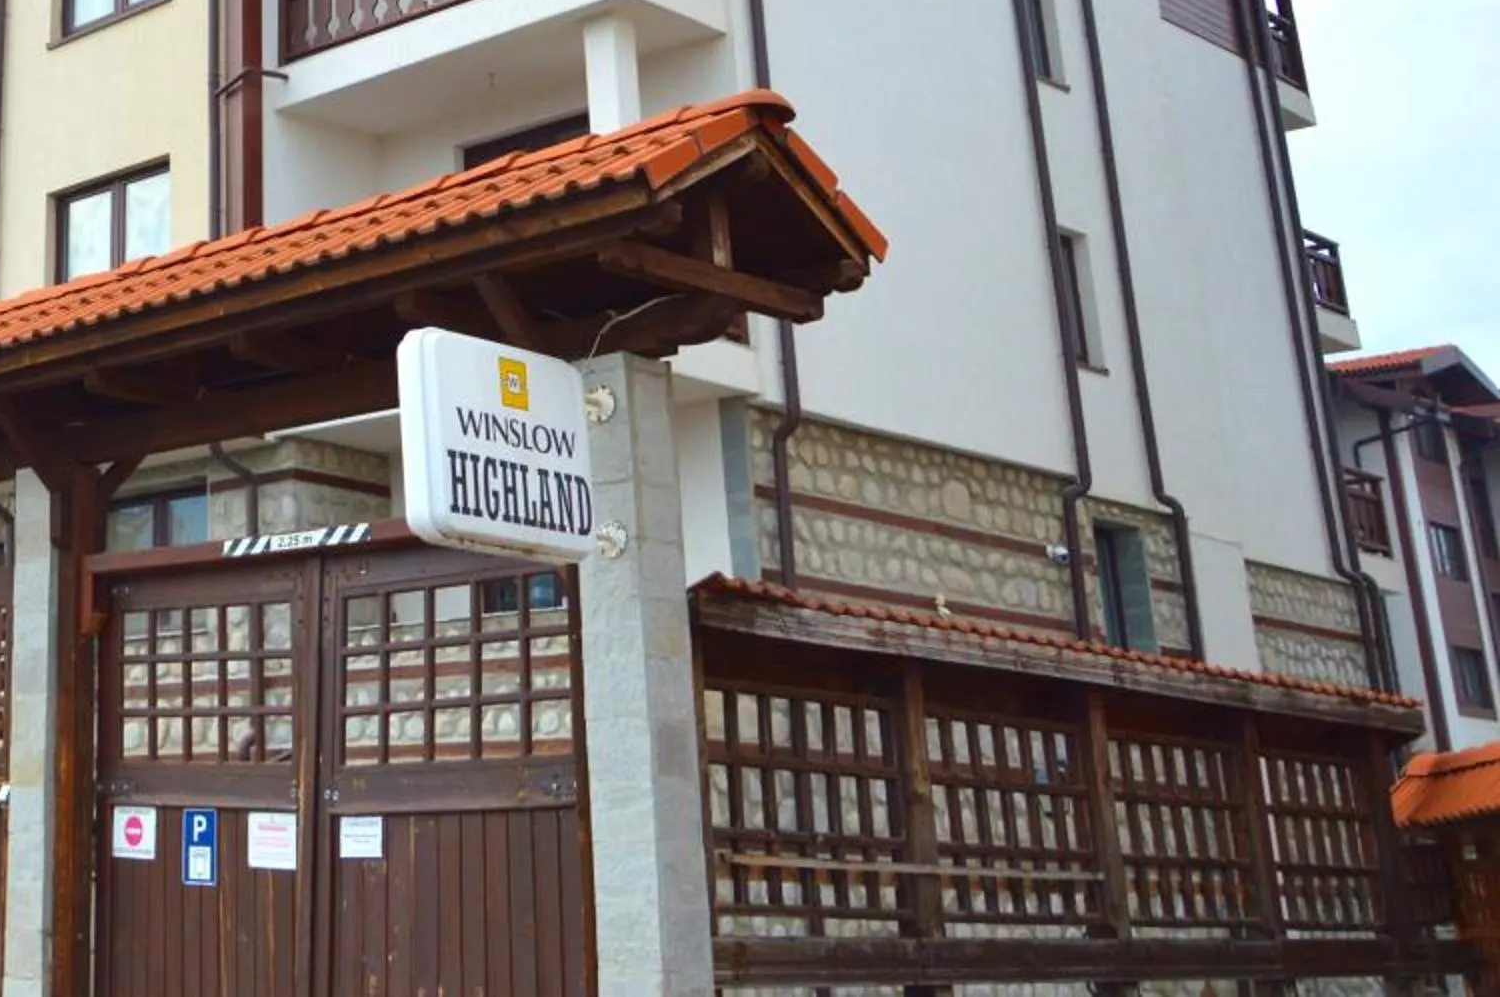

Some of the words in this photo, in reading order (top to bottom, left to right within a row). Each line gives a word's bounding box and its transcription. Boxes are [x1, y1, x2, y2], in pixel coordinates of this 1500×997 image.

[456, 406, 576, 460] WINSLOW
[447, 449, 593, 536] HIGHLAND
[193, 814, 207, 843] P
